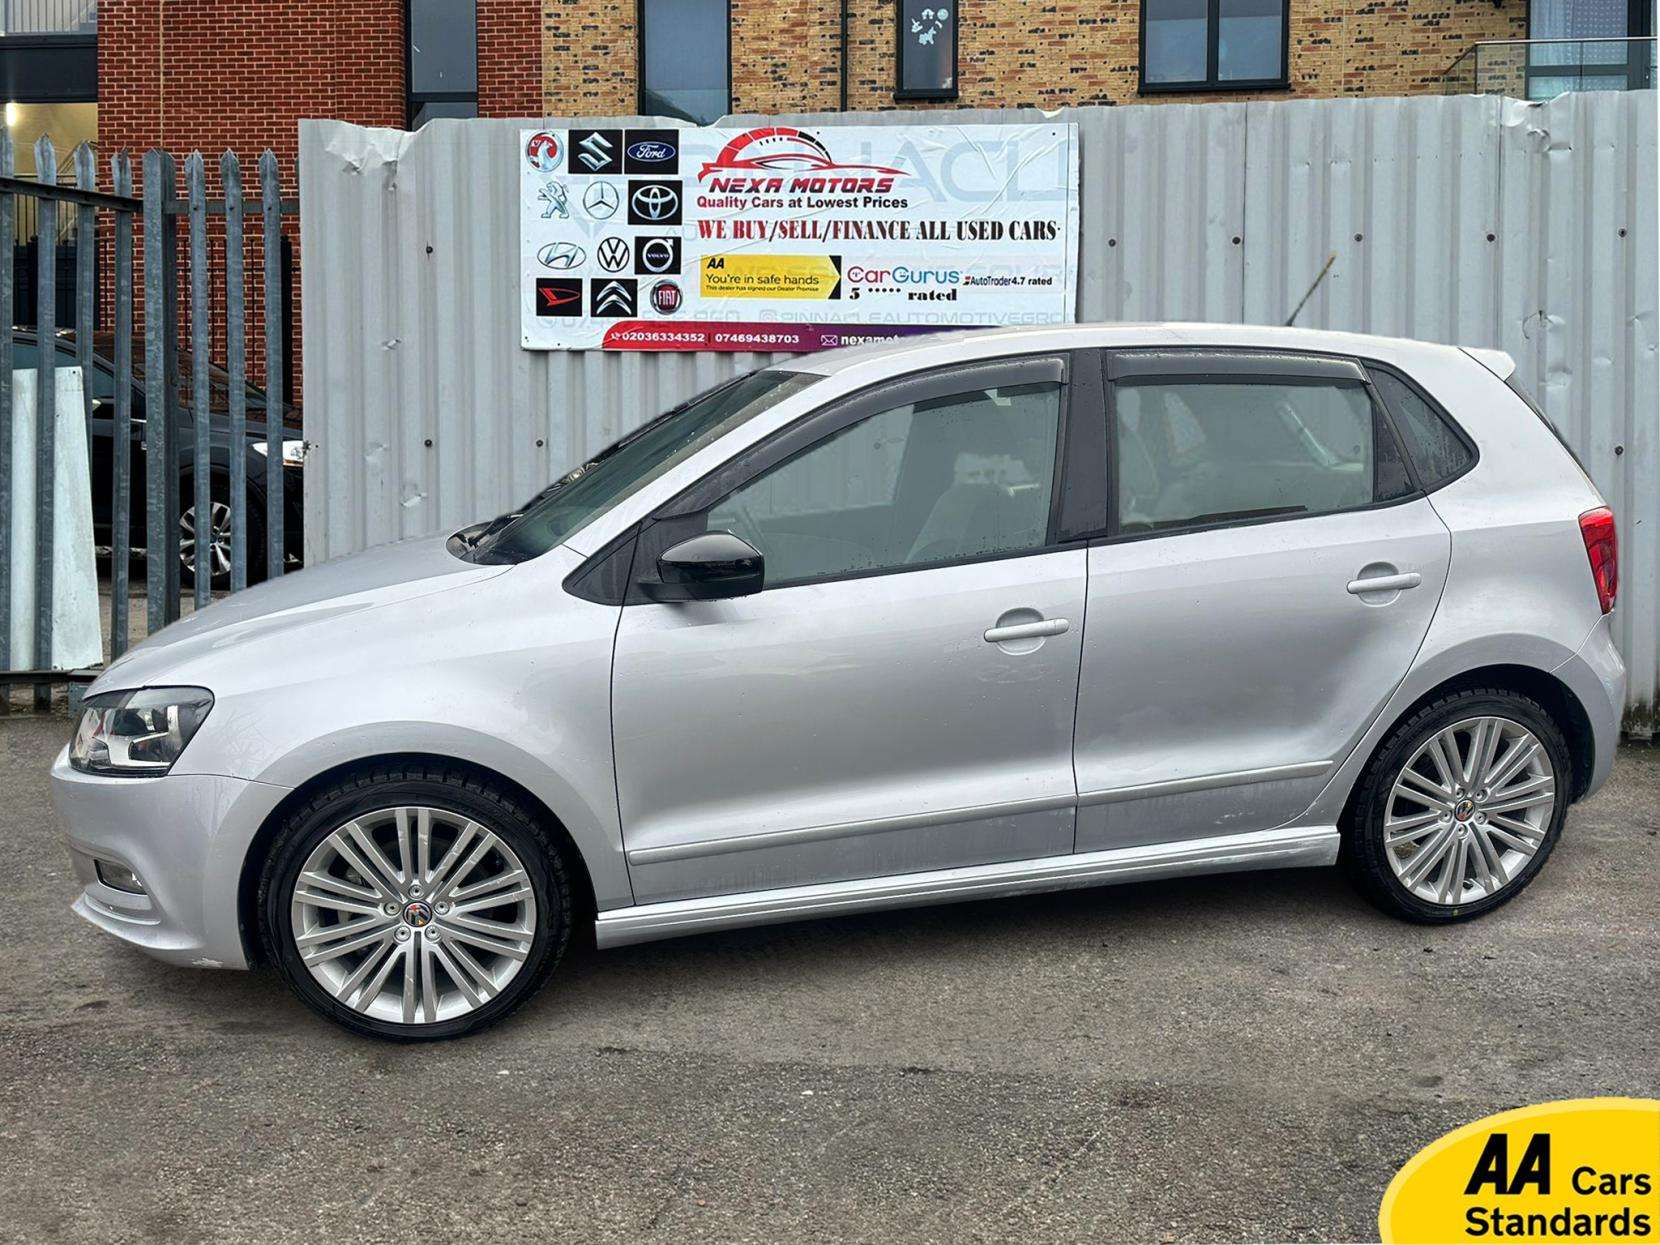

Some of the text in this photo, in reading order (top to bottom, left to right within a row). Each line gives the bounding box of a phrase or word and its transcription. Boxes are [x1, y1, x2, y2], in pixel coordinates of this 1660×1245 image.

[637, 145, 665, 158] Ford
[709, 178, 894, 193] NEXA MOTORS
[697, 196, 908, 210] Quality Cars at Lowest Prices
[697, 219, 1057, 242] WE BUY/SELL/FINANCE ALL USED CARS
[706, 257, 725, 269] AA
[706, 273, 819, 285] You're in safe hands
[847, 266, 960, 284] CarGurus
[1028, 276, 1053, 286] rated
[658, 290, 677, 306] FIAT
[849, 287, 957, 301] 5 rated
[622, 333, 705, 342] 02036334352
[715, 334, 799, 343] 07469438703
